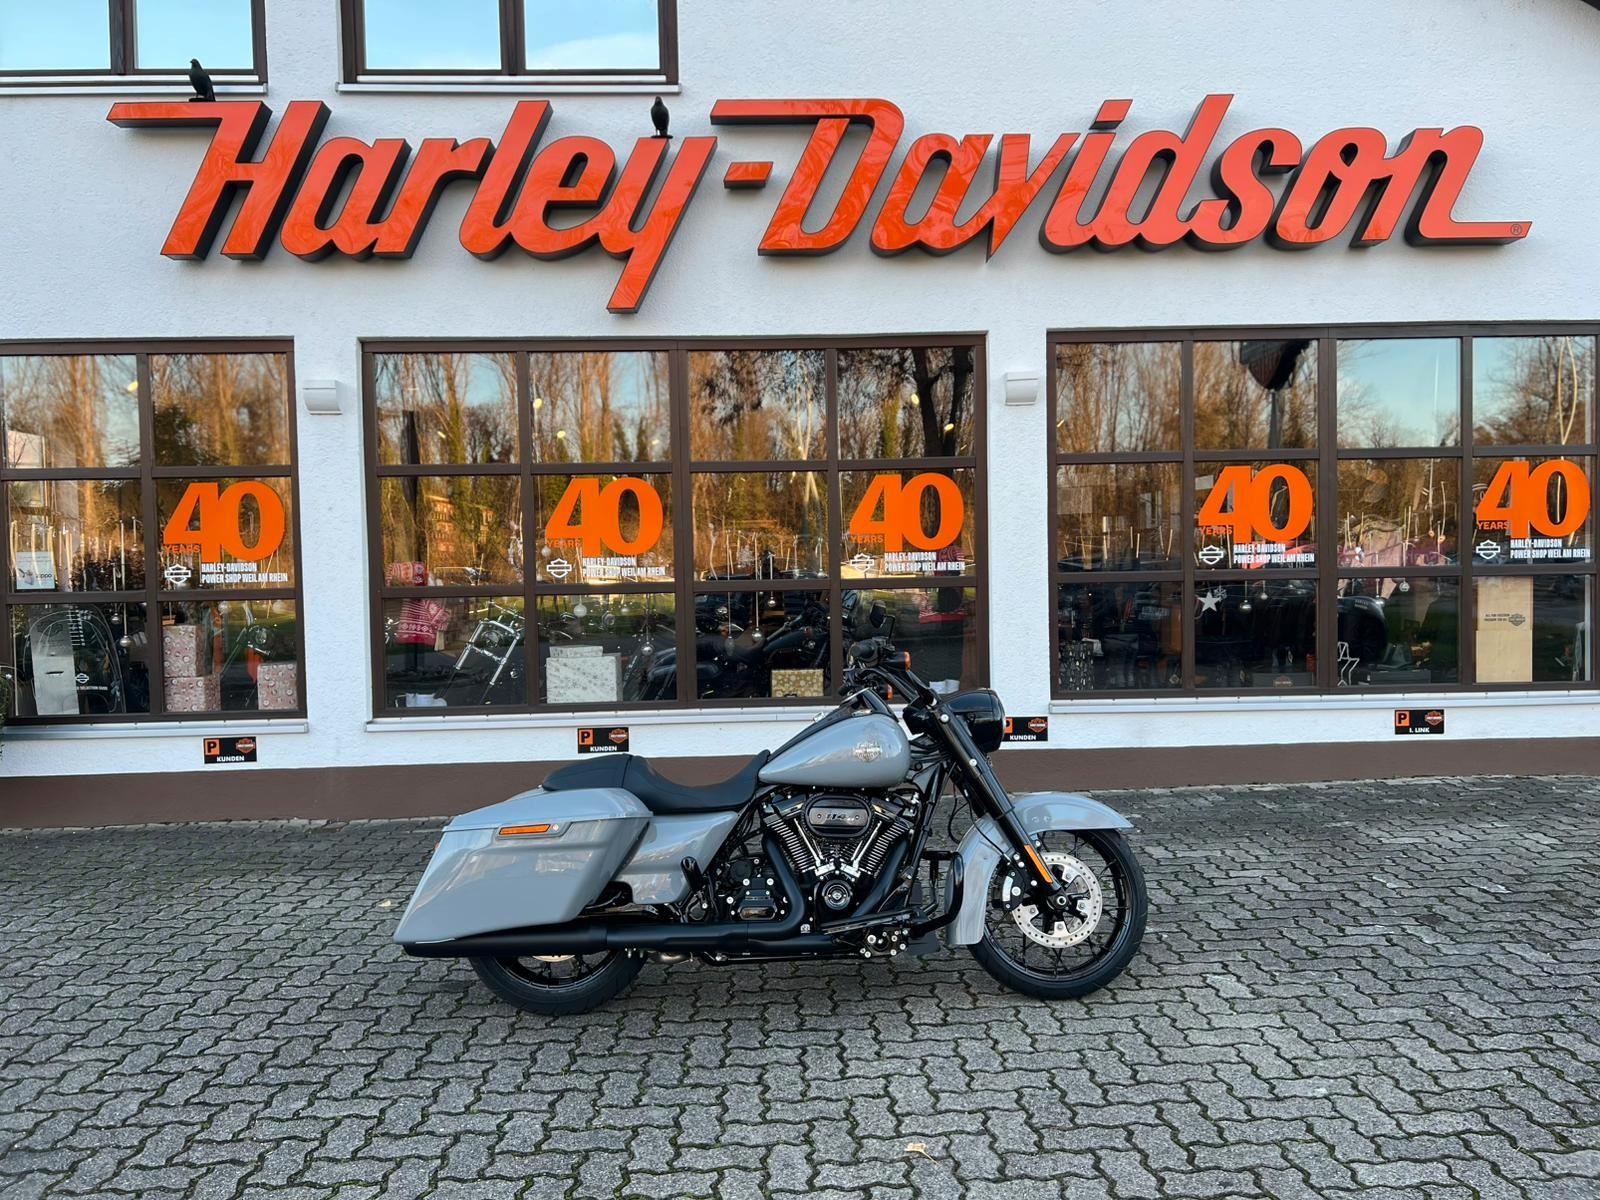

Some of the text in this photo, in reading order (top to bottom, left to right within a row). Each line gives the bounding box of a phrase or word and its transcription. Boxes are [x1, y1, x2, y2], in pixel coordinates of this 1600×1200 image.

[106, 94, 1532, 313] Harley-Davidson
[1199, 464, 1314, 543] 40
[1476, 459, 1591, 538] 40
[545, 477, 664, 556] 40
[849, 472, 965, 552] 40
[163, 481, 286, 564] 40
[1478, 521, 1509, 530] YEARS
[1200, 526, 1233, 536] YEARS
[850, 535, 884, 544] YEARS
[1510, 538, 1562, 548] HARLEY-DAVIDSON
[165, 544, 200, 554] YEARS
[1233, 544, 1286, 553] HARLEY-DAVIDSON
[1510, 549, 1531, 559] POWER
[1531, 549, 1547, 559] SHOP
[1572, 548, 1590, 558] RHEIN
[582, 557, 636, 566] HARLEY-DAVIDSON
[884, 552, 936, 561] HARLEY-DAVIDSON
[1233, 554, 1255, 564] POWER
[1255, 554, 1270, 564] SHOP
[1296, 553, 1315, 562] RHEIN
[202, 562, 257, 572] HARLEY-DAVIDSON
[582, 567, 604, 577] POWER
[605, 567, 620, 577] SHOP
[647, 566, 666, 576] RHEIN
[884, 562, 906, 572] POWER
[906, 562, 922, 572] SHOP
[947, 561, 966, 571] RHEIN
[202, 573, 225, 584] POWER
[226, 573, 242, 582] SHOP
[270, 572, 288, 582] RHEIN
[1398, 713, 1407, 724] P
[580, 730, 590, 742] P
[207, 741, 217, 754] P
